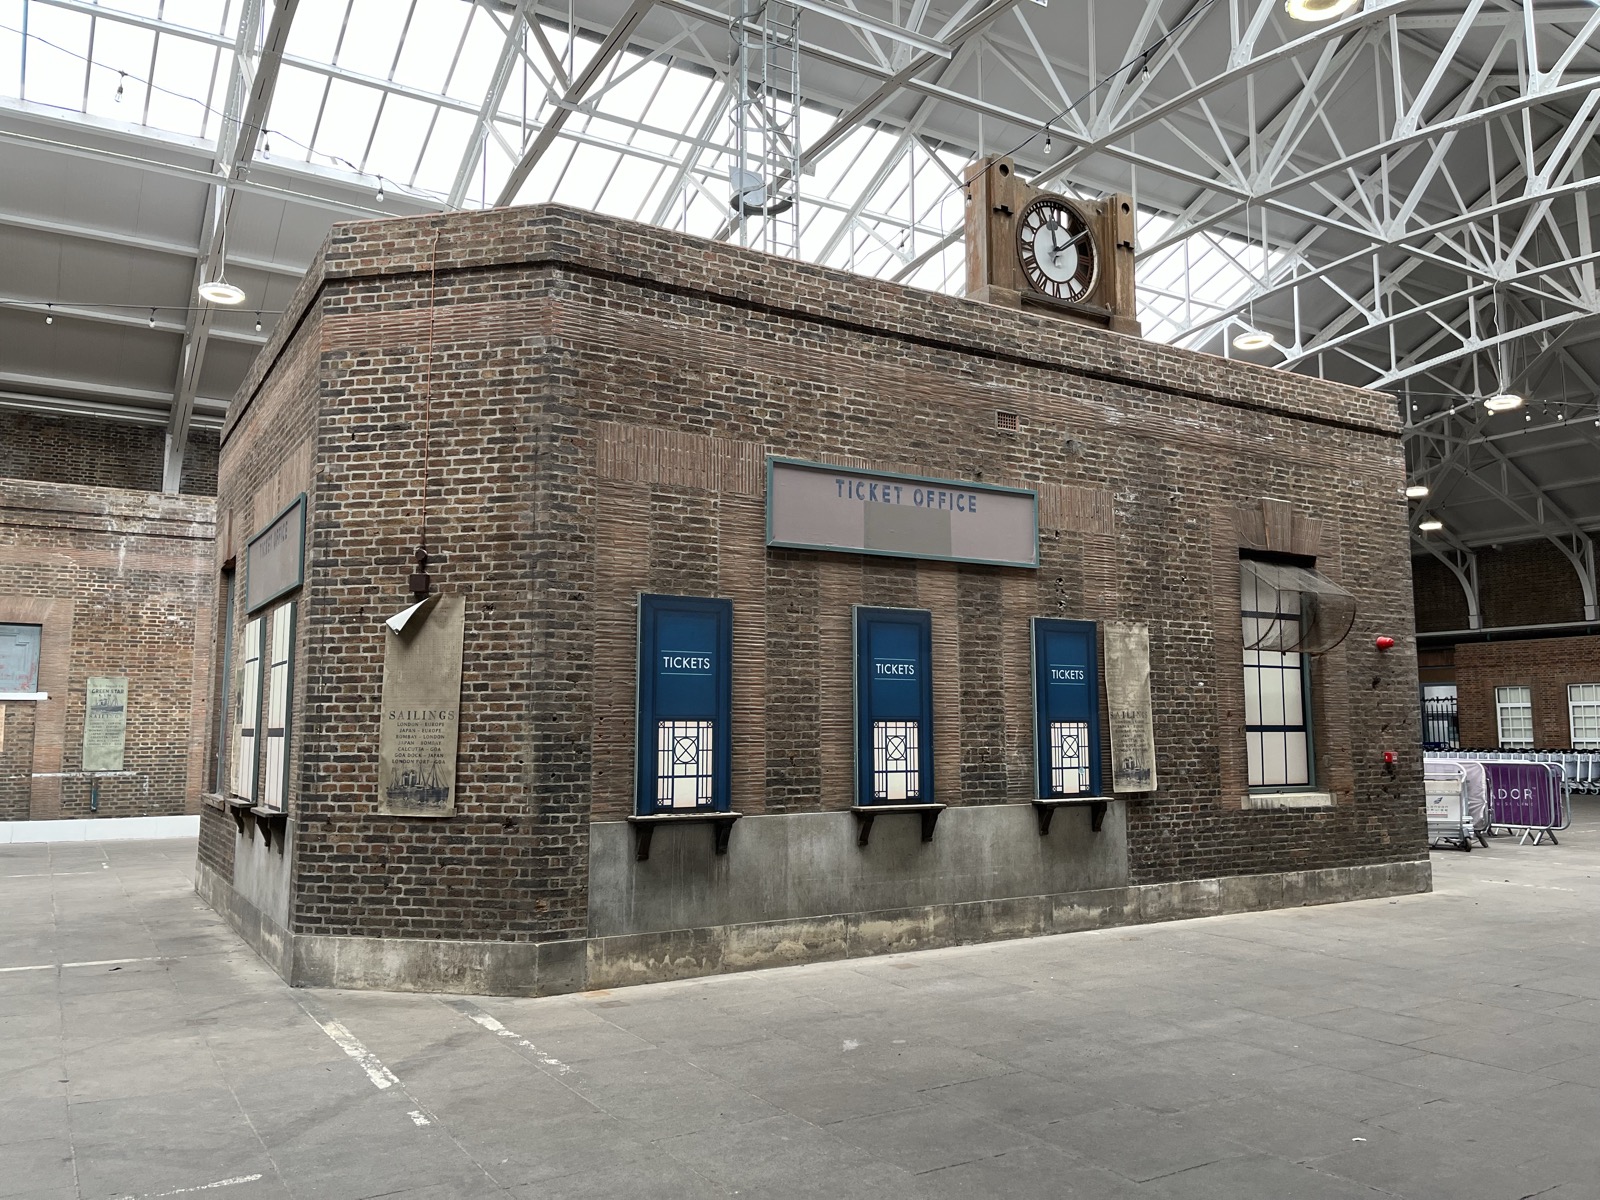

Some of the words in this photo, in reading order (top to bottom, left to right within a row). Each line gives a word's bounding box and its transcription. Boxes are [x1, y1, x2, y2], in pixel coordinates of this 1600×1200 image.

[835, 478, 903, 504] TICKET
[913, 488, 977, 513] OFFICE
[663, 656, 711, 669] TICKETS
[875, 663, 915, 675] TICKETS
[1051, 669, 1084, 680] TICKETS
[388, 710, 455, 720] SAILINGS
